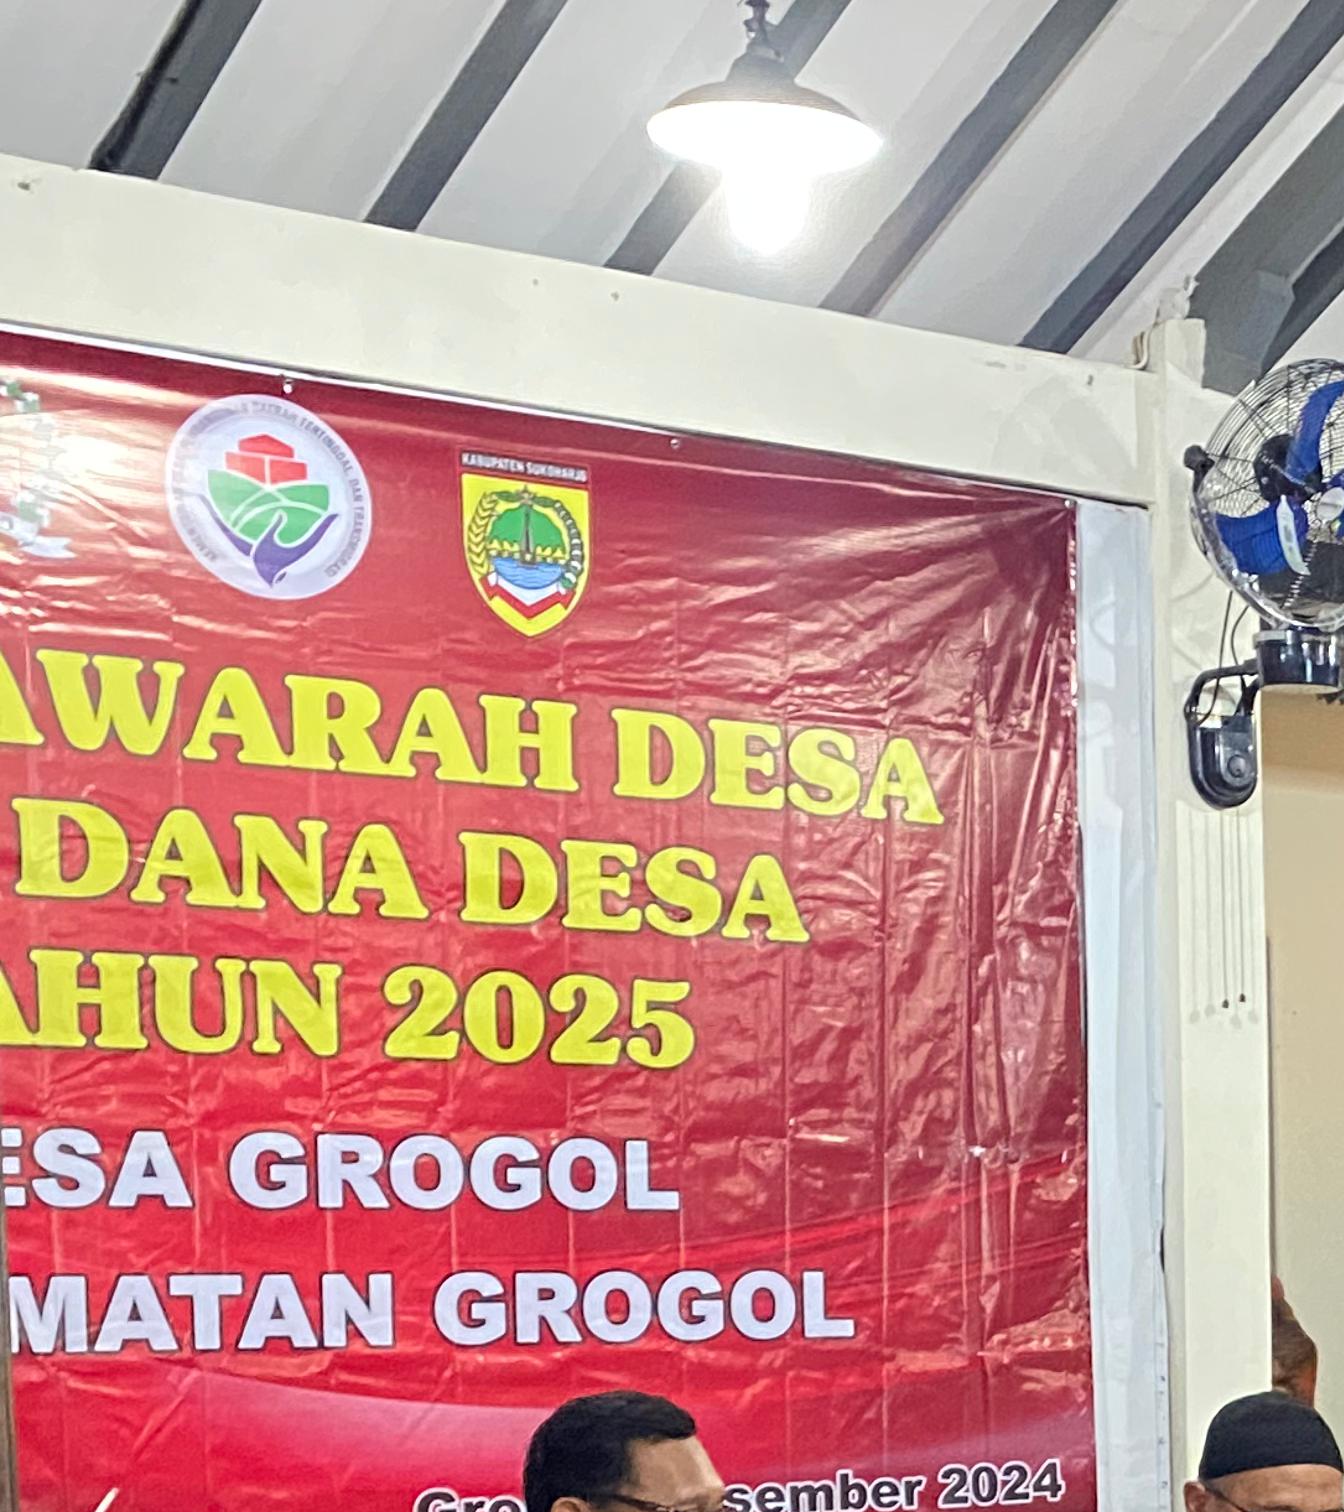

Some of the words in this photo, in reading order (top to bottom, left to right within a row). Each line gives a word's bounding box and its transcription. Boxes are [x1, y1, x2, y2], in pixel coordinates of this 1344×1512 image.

[611, 708, 945, 825] DESA
[12, 797, 429, 921] DANA
[459, 830, 810, 942] DESA
[383, 964, 696, 1069] 2025
[229, 1132, 680, 1211] GROGOL
[433, 1269, 856, 1346] GROGOL
[939, 1459, 1064, 1508] 2024
